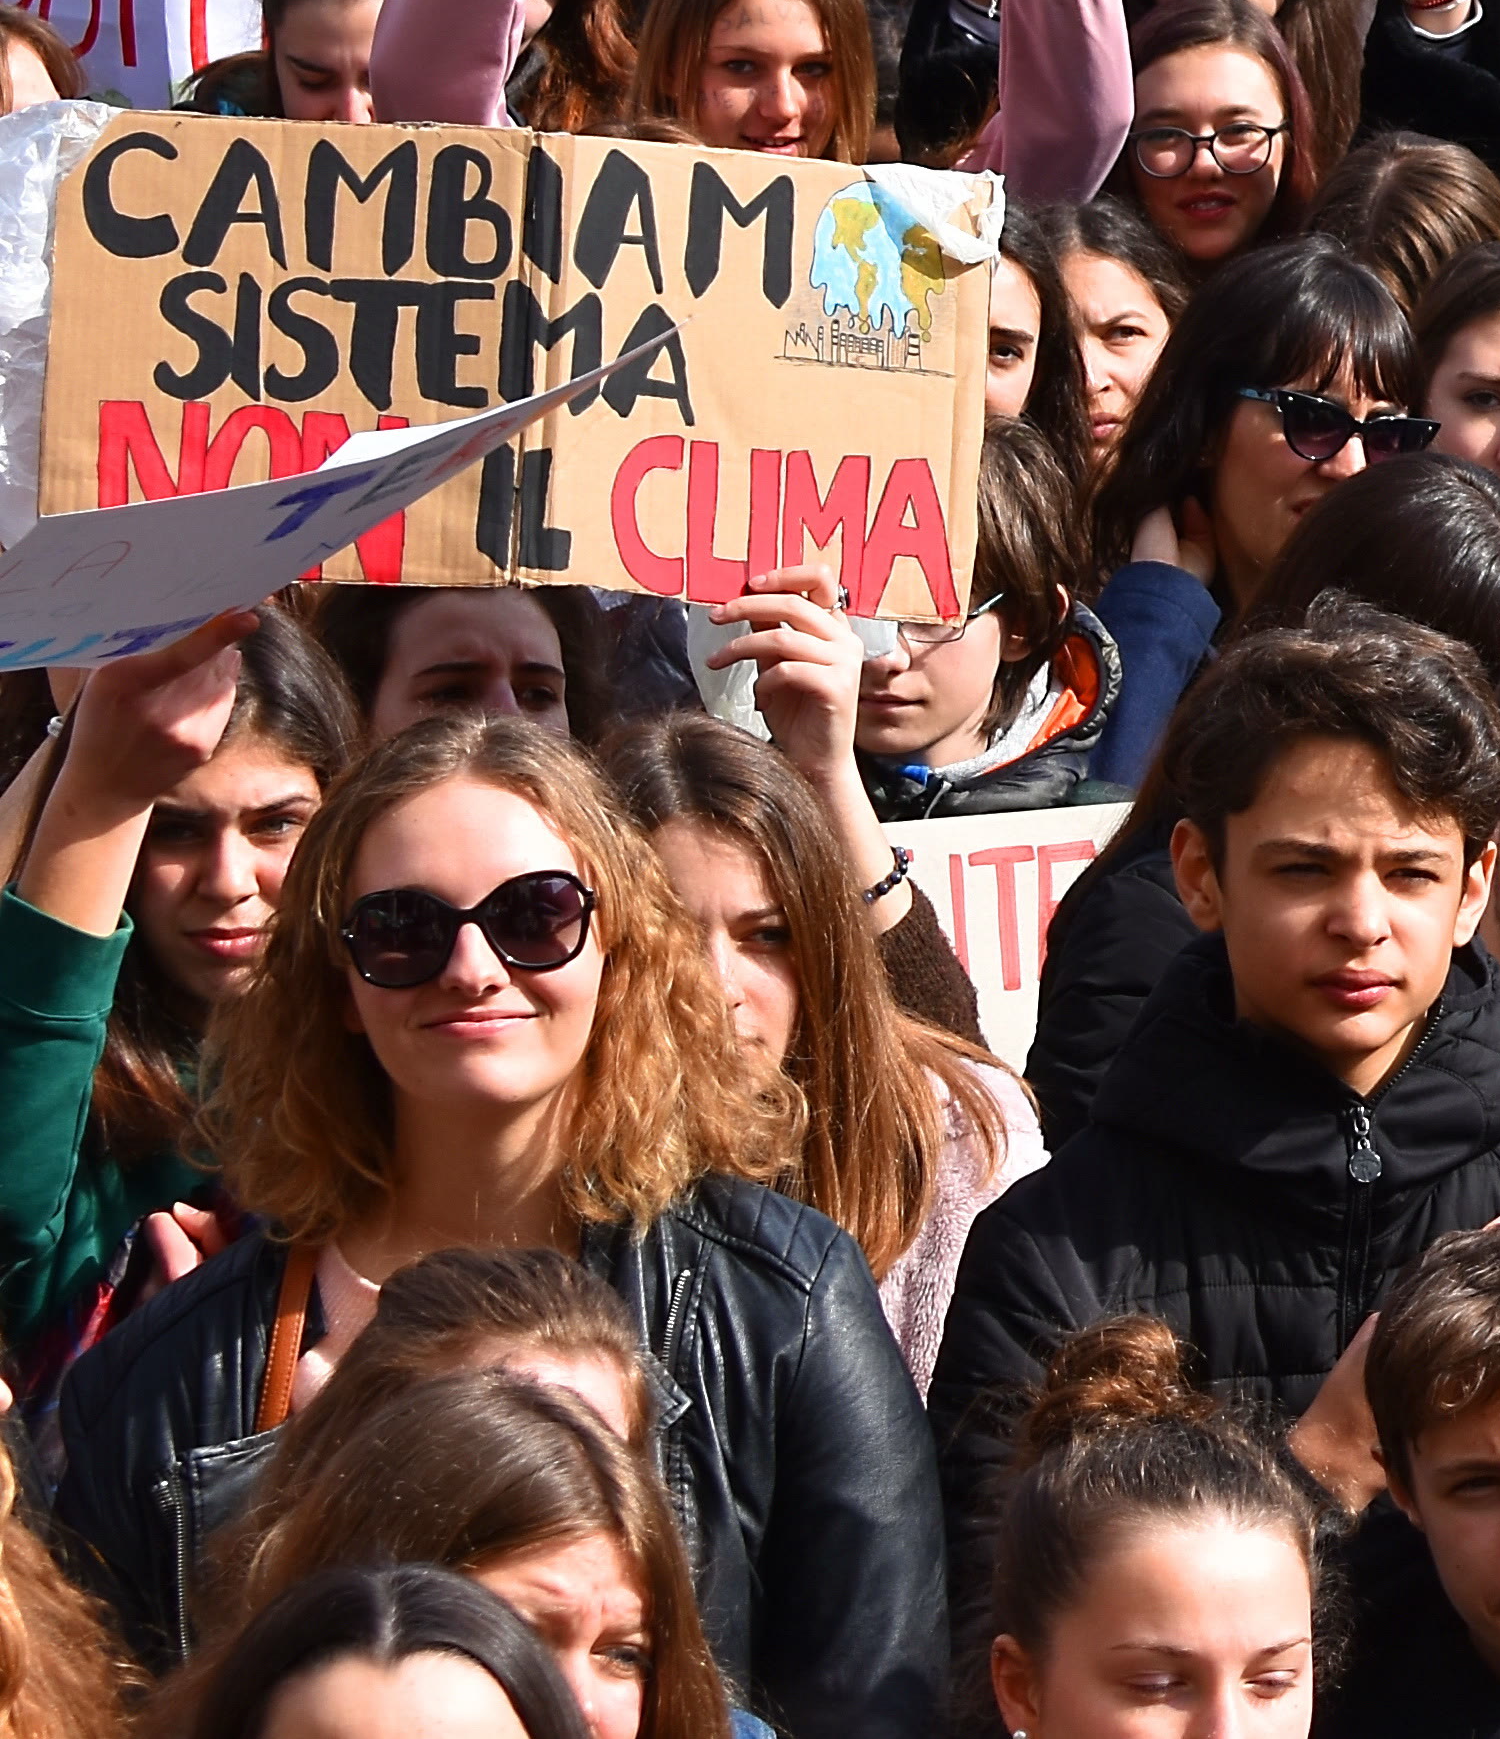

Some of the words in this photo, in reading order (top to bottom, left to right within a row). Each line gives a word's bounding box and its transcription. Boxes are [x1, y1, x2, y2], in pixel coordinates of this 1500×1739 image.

[152, 270, 694, 428] SISTEMA
[475, 444, 572, 571] IL
[610, 435, 963, 627] CLIMA
